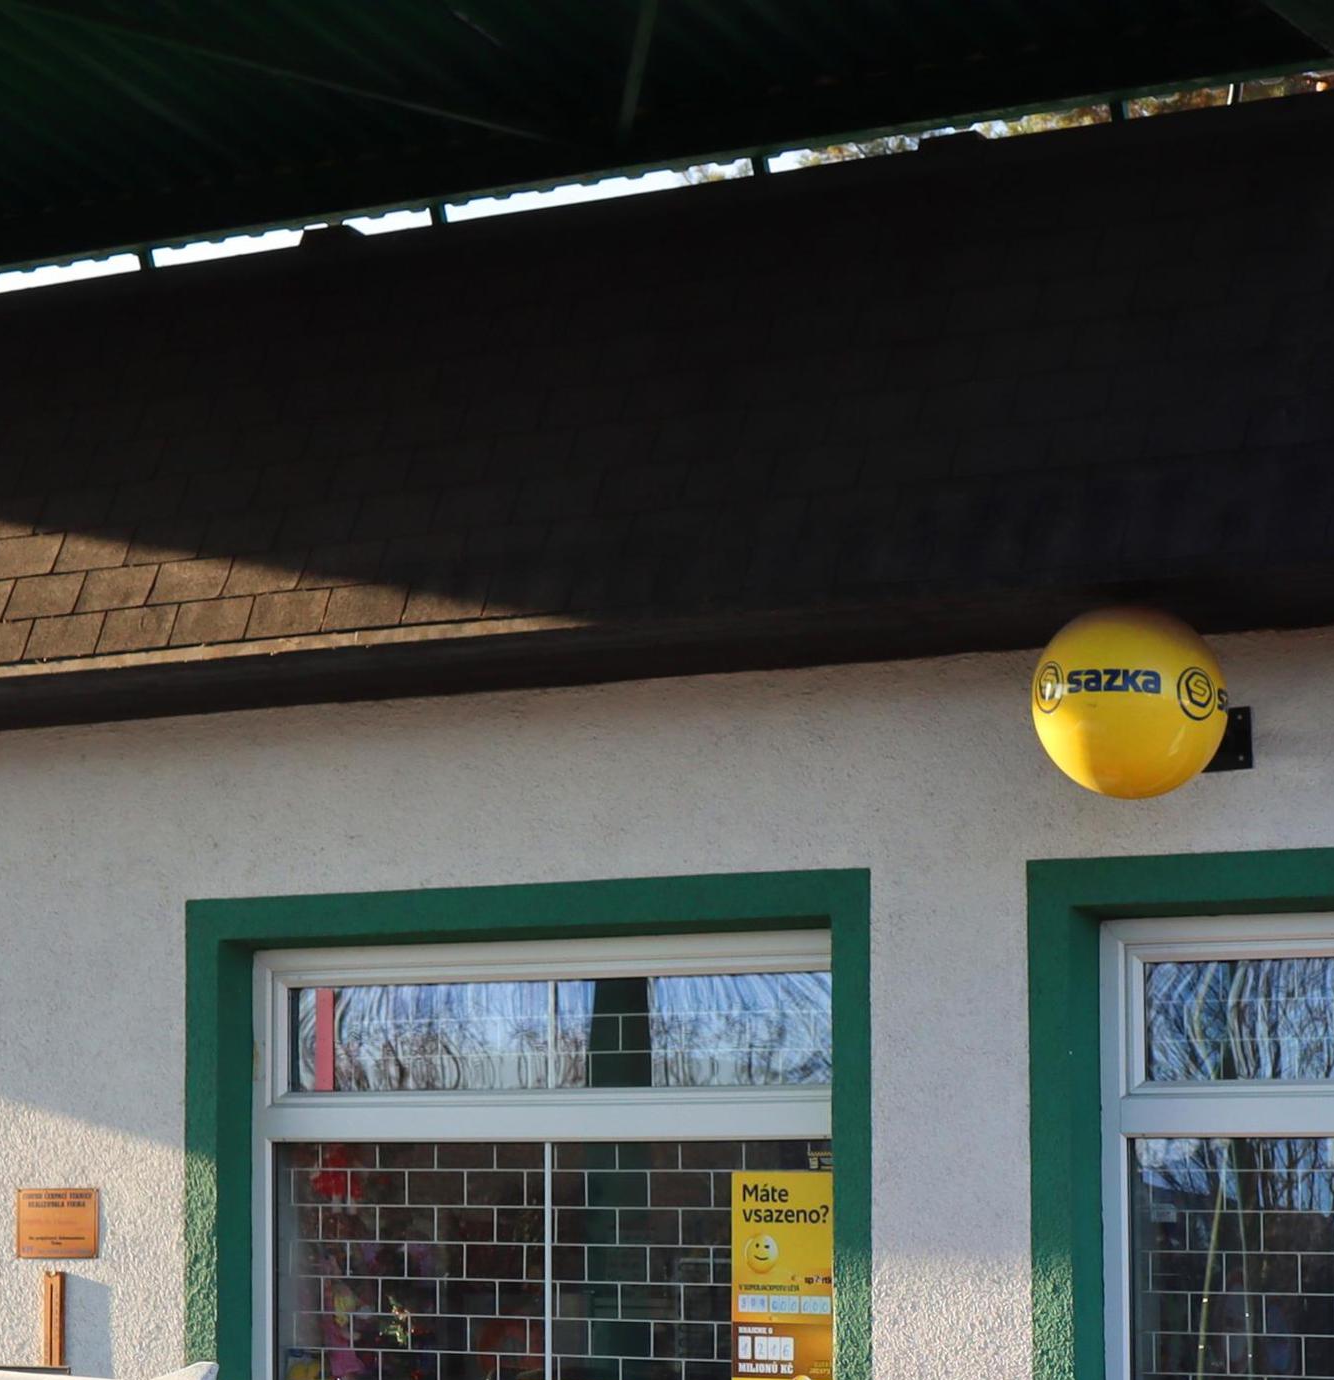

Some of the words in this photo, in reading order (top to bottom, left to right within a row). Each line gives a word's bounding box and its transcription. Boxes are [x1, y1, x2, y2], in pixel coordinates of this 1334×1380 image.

[1067, 669, 1162, 694] sazka
[742, 1183, 789, 1203] Máte
[742, 1205, 829, 1224] vsazeno?
